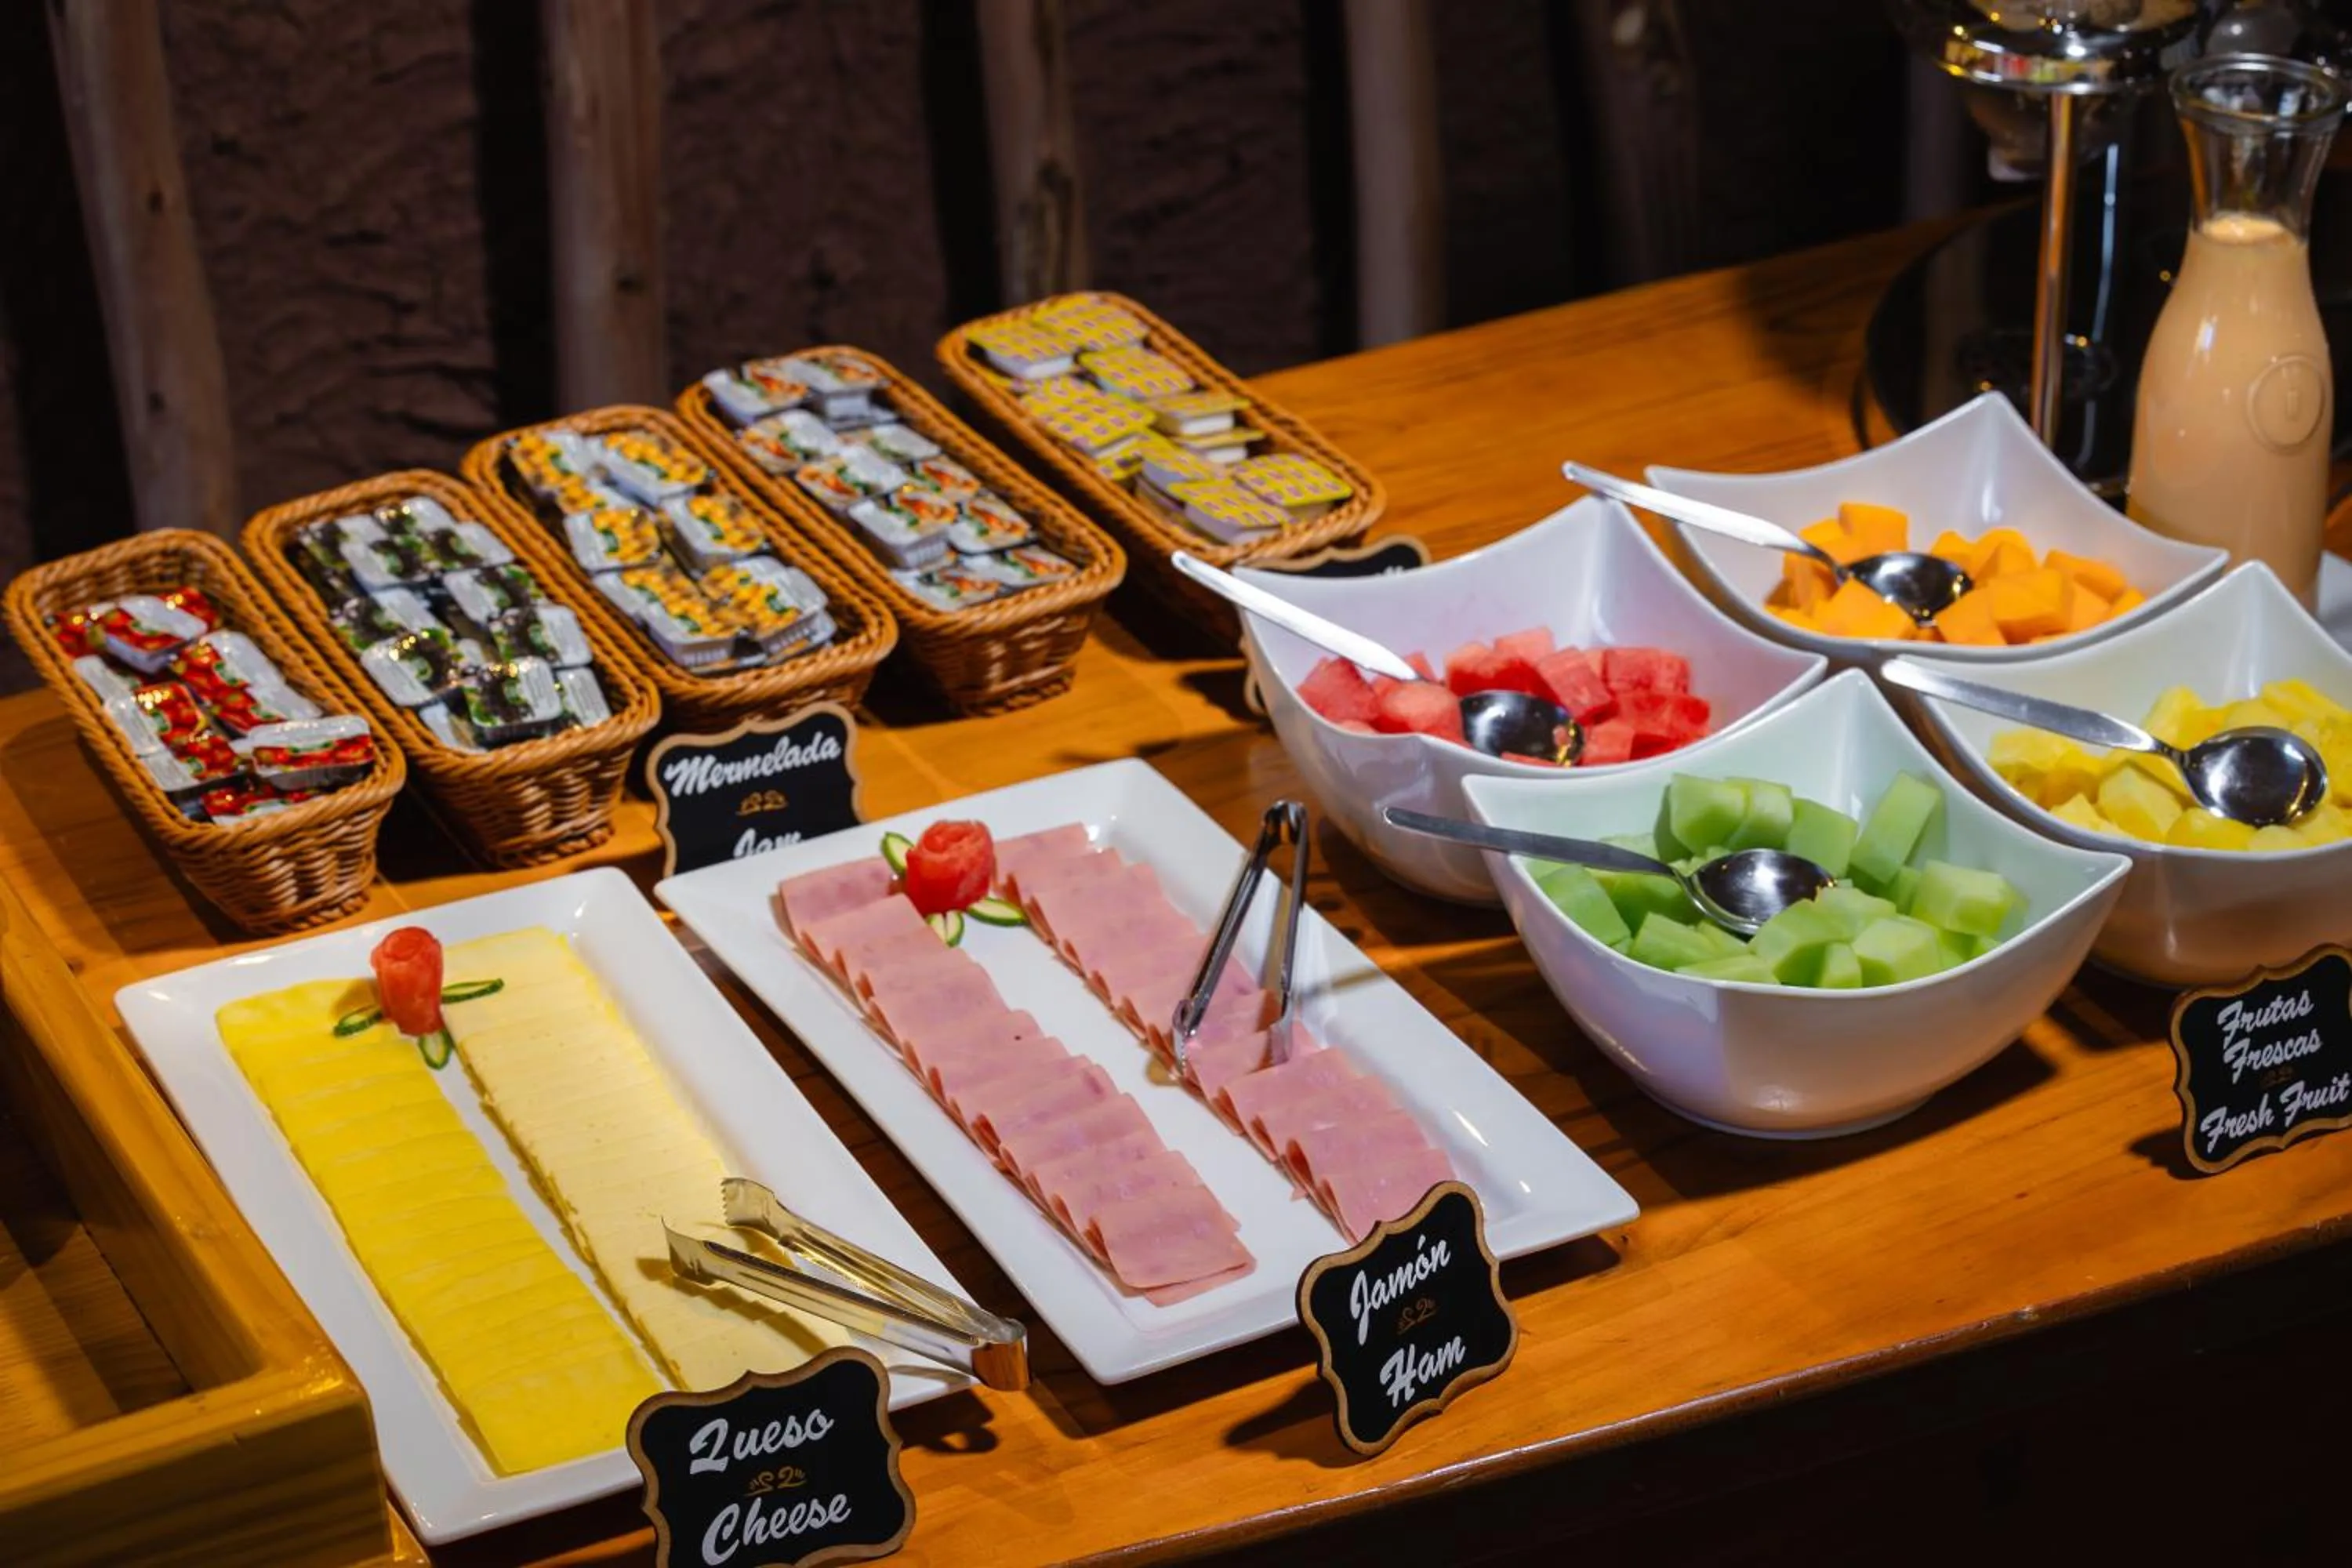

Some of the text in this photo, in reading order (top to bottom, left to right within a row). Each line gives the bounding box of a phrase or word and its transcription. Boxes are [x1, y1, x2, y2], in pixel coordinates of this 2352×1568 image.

[664, 731, 840, 797] Mermelada
[2217, 990, 2314, 1050] Frutas
[2223, 1029, 2322, 1084] Frescas
[2200, 1073, 2350, 1153] Fresh Fruit
[1350, 1235, 1450, 1345] Jamón
[1380, 1336, 1466, 1407] Ham
[690, 1408, 834, 1475] Queso
[702, 1494, 851, 1566] Cheese
